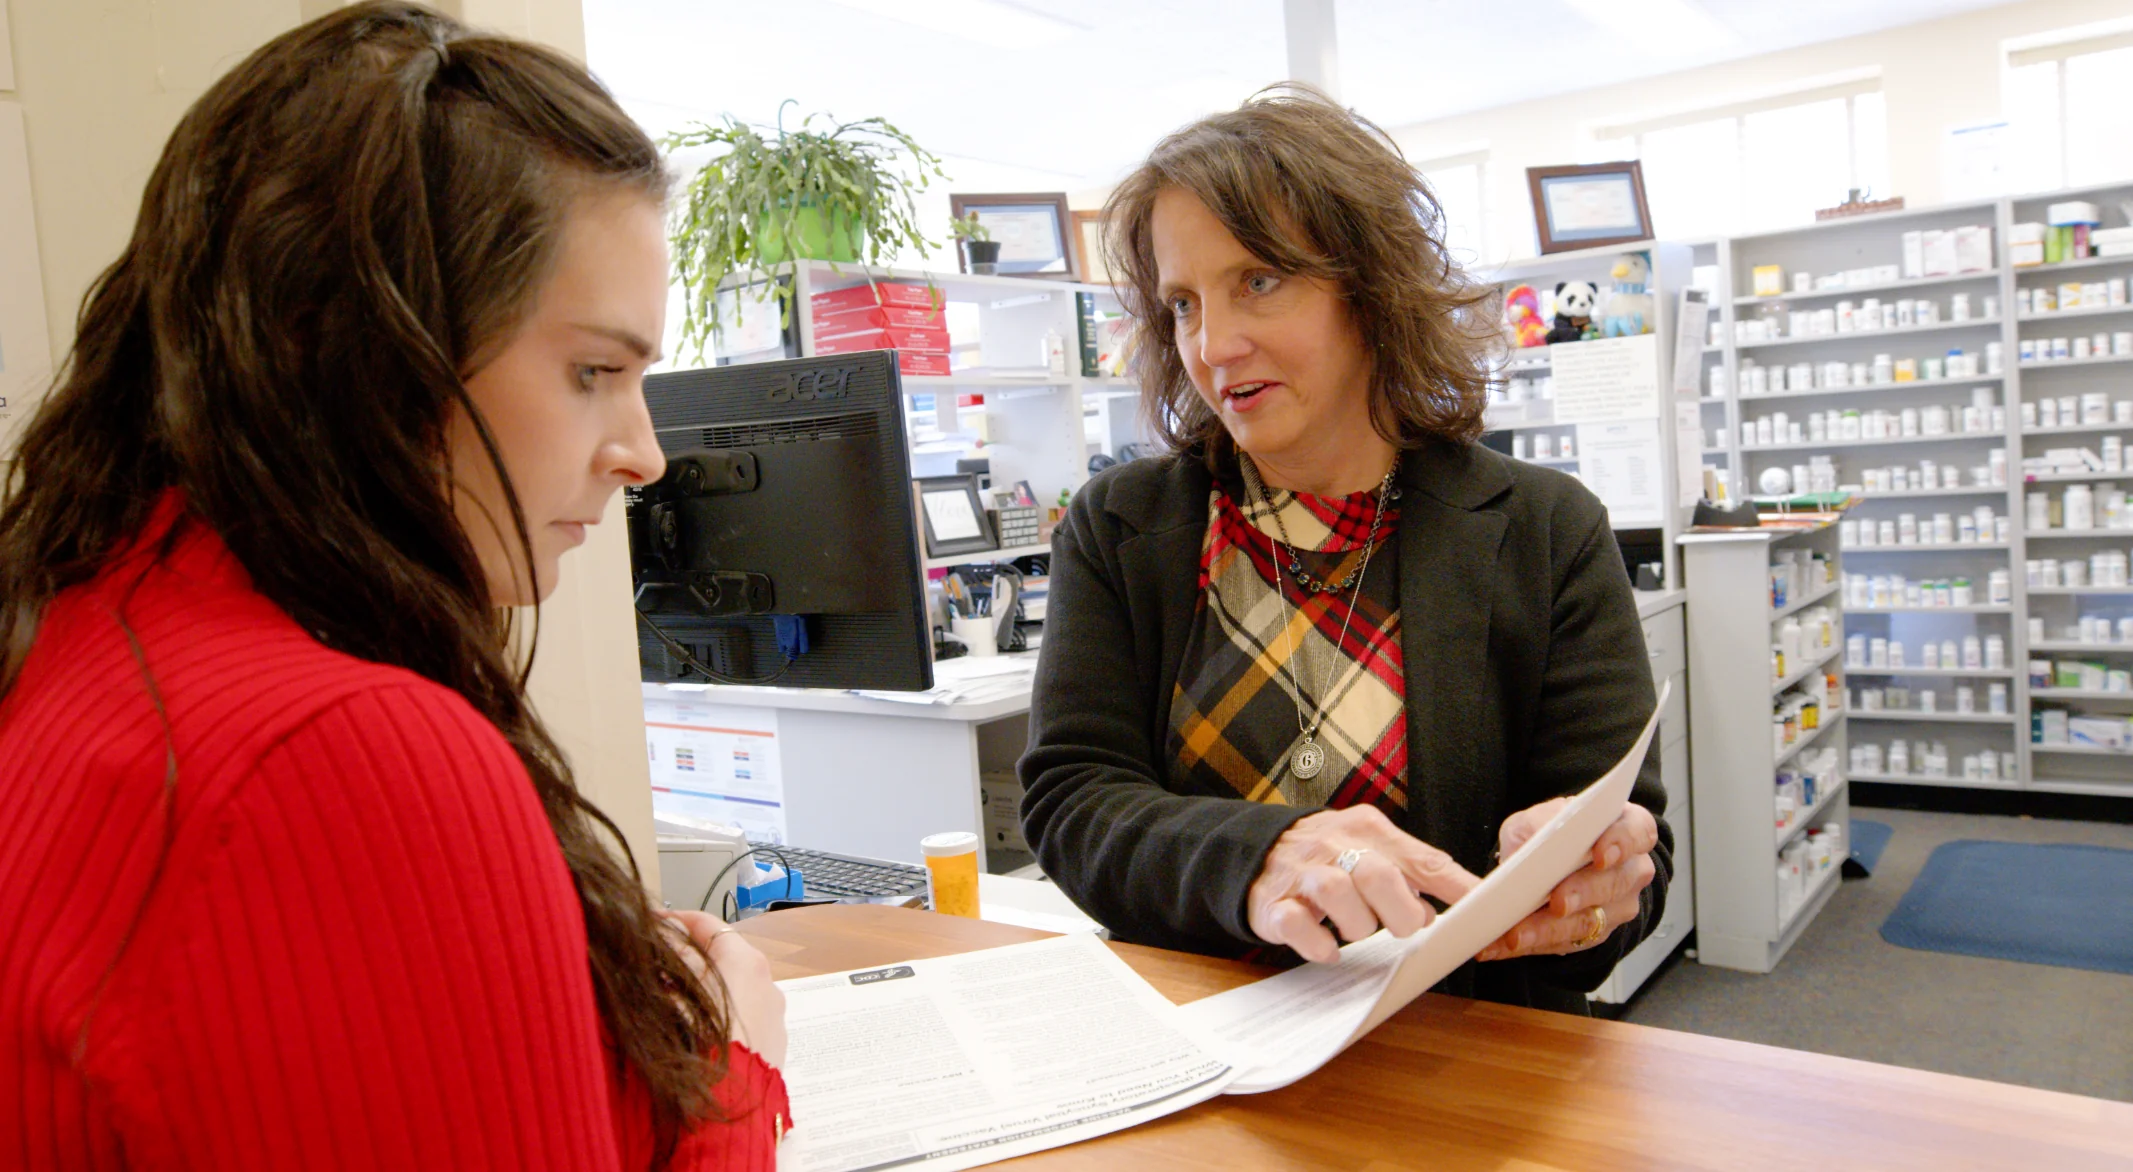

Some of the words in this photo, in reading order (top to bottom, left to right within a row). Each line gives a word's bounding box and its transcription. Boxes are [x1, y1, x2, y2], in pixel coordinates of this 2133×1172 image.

[767, 366, 863, 402] acer
[859, 974, 879, 982] CDC
[1186, 1059, 1218, 1075] What
[1157, 1073, 1180, 1085] You
[1117, 1081, 1153, 1096] Need
[1057, 1096, 1095, 1109] Know
[1081, 1107, 1132, 1123] VACCINE
[998, 1120, 1079, 1143] INFORMATION
[925, 1138, 995, 1159] STATEMENT
